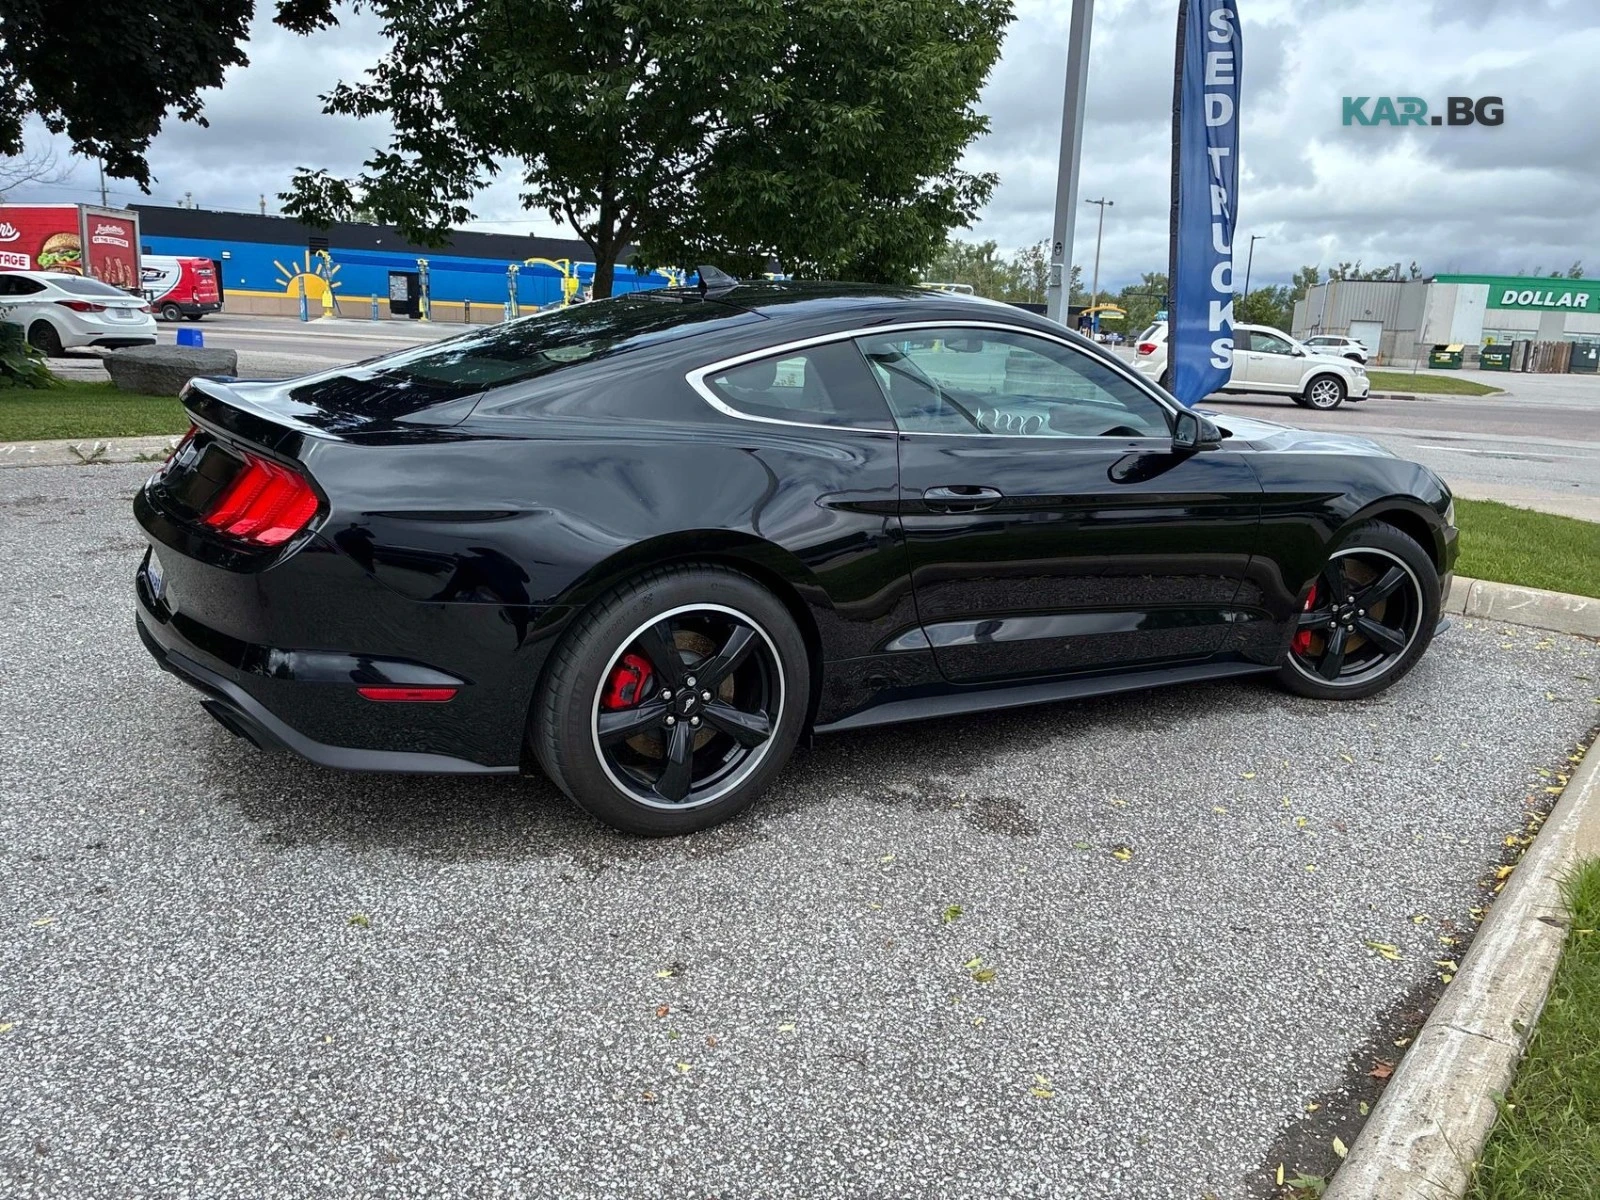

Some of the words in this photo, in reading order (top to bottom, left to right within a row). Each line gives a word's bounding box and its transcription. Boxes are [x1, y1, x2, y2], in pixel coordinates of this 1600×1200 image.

[1205, 8, 1234, 127] SED
[1208, 147, 1234, 370] TRUCKS
[1501, 290, 1590, 308] DOLLAR
